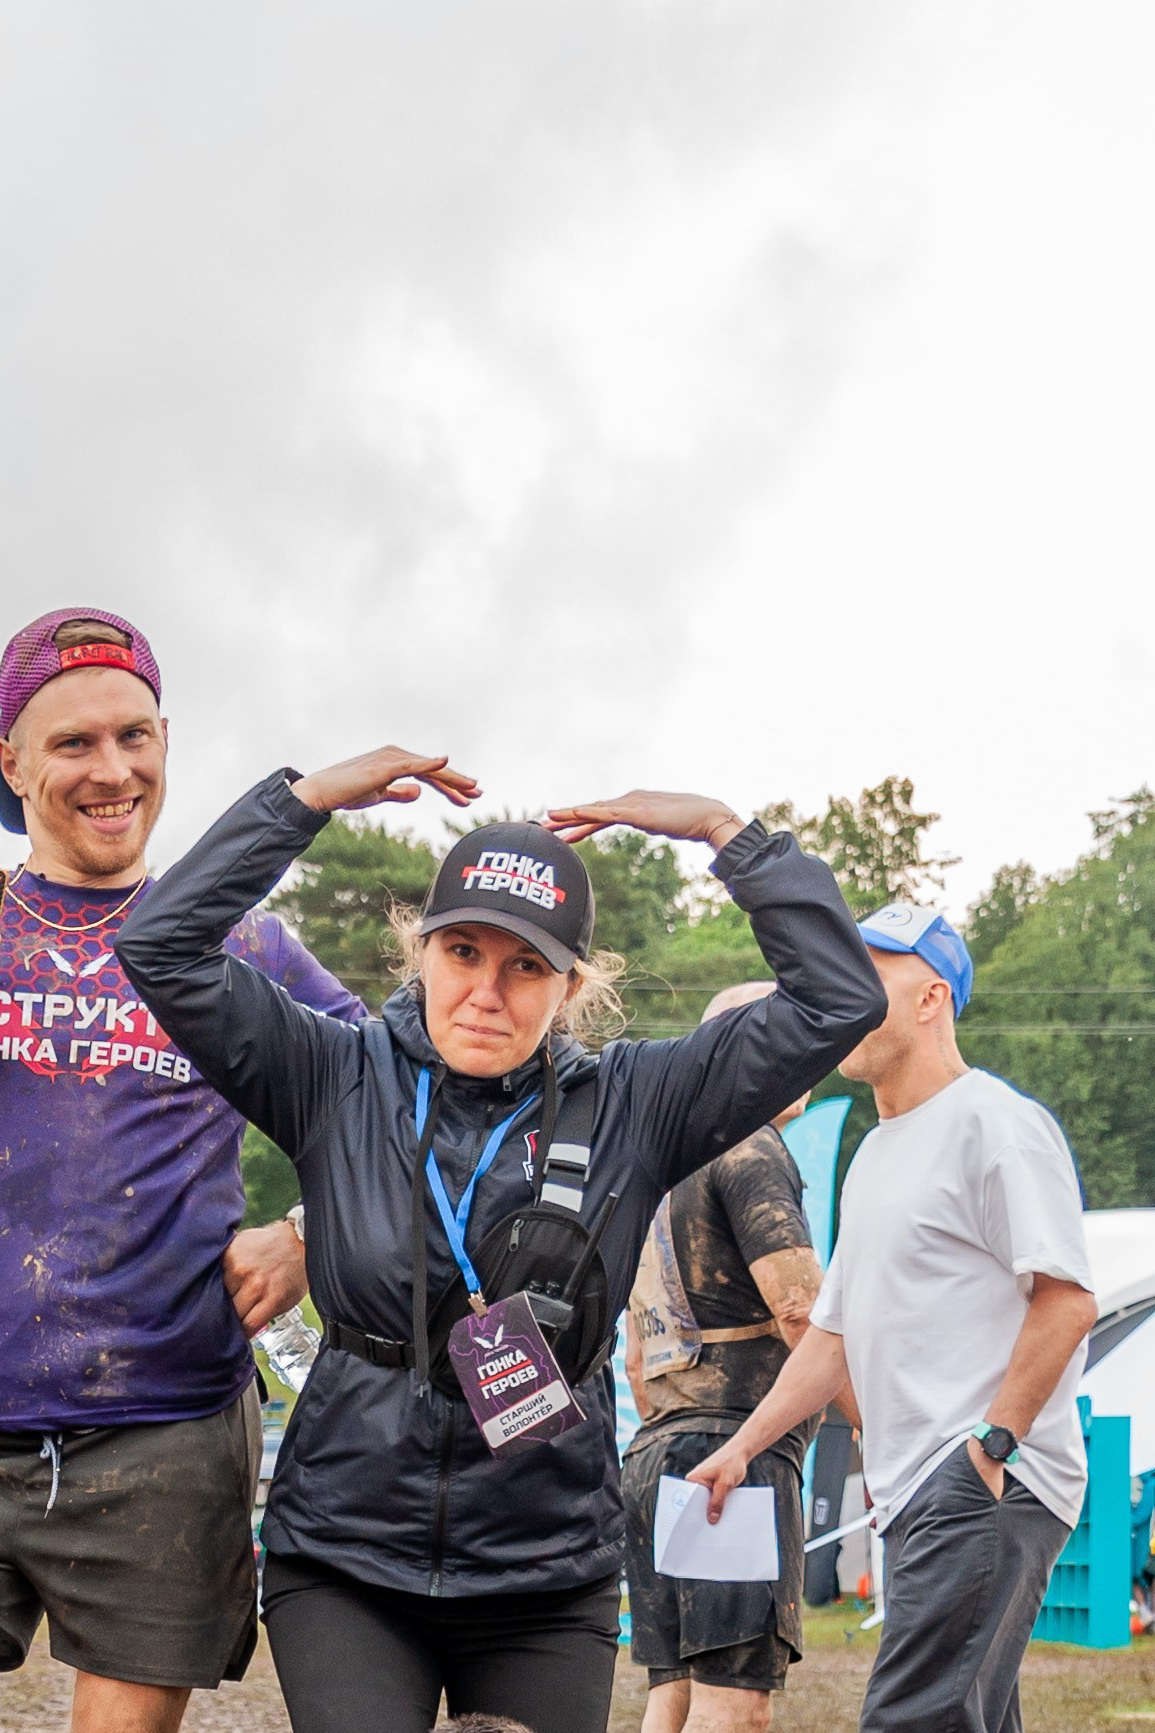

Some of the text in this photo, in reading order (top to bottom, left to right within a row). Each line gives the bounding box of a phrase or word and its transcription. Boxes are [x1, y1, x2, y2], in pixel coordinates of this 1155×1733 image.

[476, 851, 554, 888] ГОНКА
[464, 870, 557, 910] ГЕРОЕВ
[68, 1039, 192, 1084] ГЕРОЕВ
[476, 1349, 528, 1380] ГОНКА
[481, 1365, 539, 1400] ГЕРОЕВ
[499, 1393, 547, 1426] СТАРШИЙ
[502, 1403, 553, 1437] ВОЛОНТЁР
